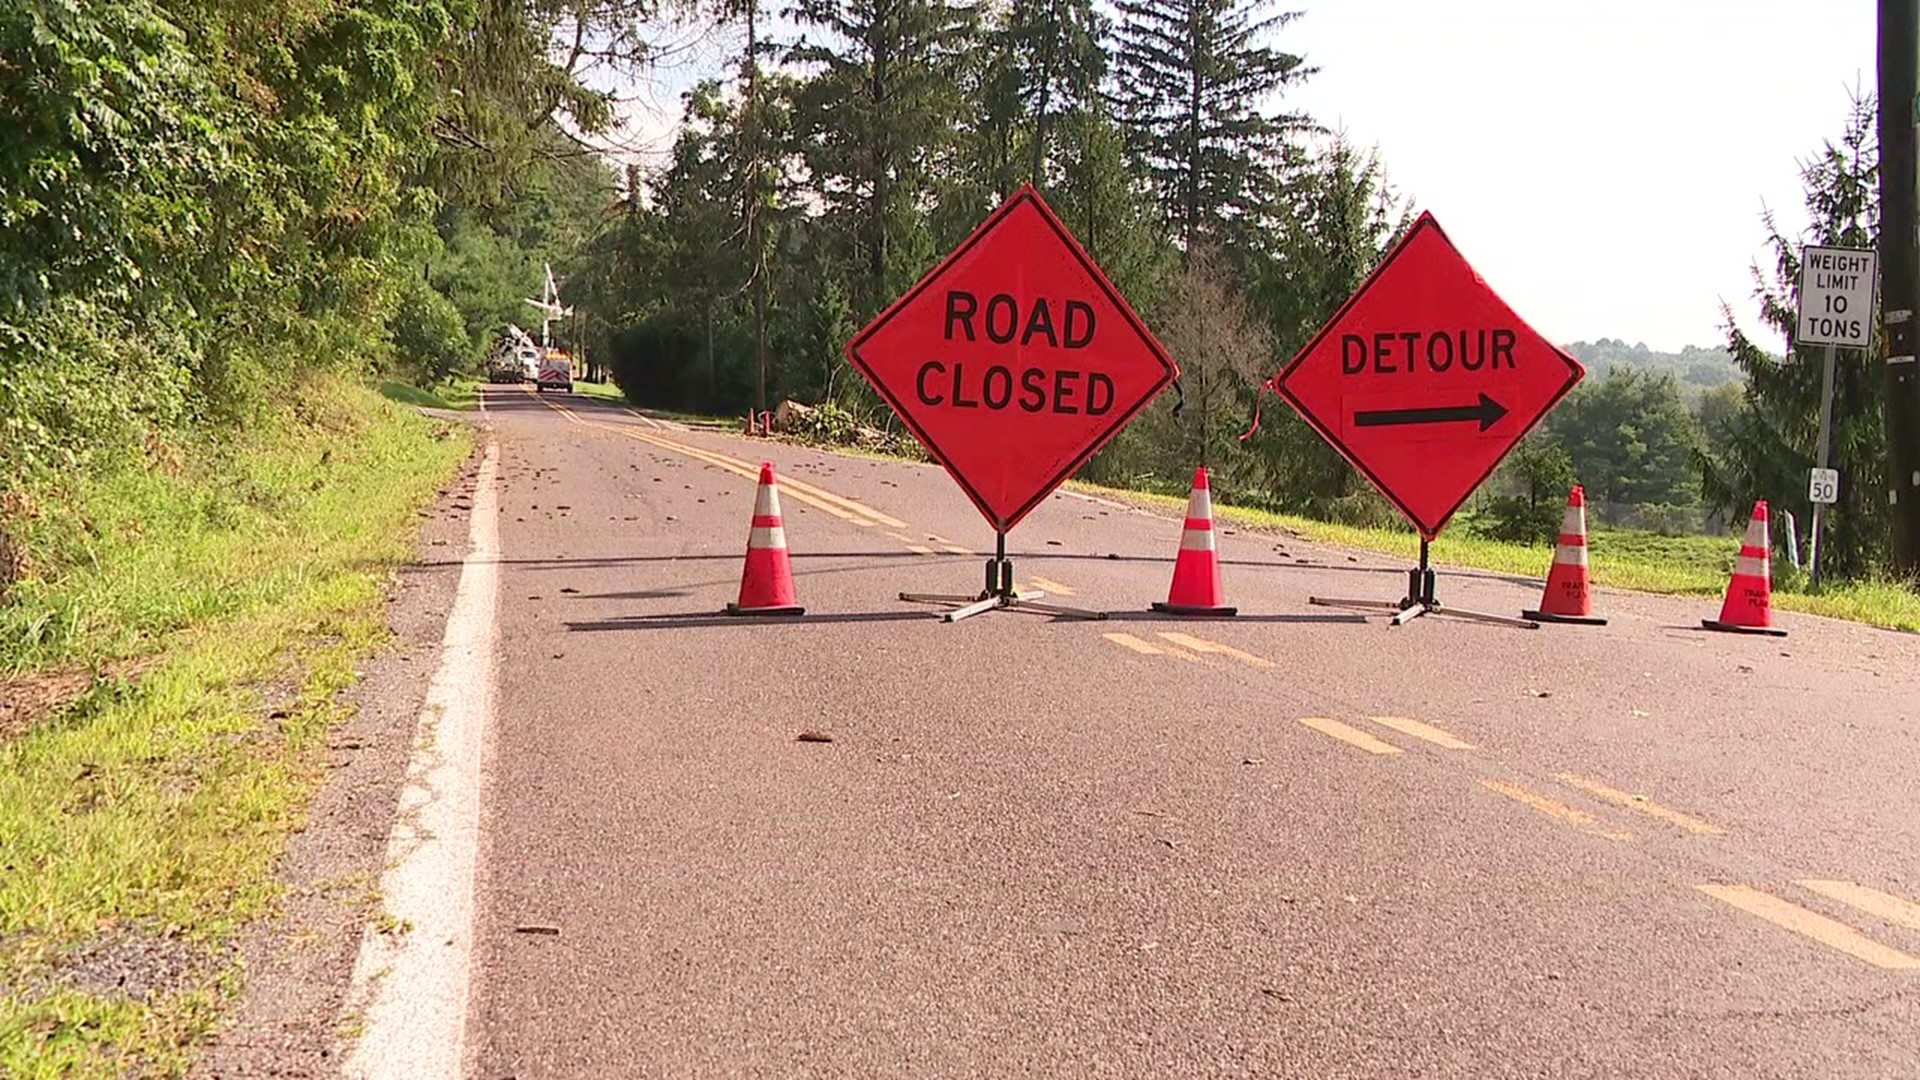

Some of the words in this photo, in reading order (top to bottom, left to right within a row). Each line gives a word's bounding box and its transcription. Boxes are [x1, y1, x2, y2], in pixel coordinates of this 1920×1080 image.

[1810, 254, 1870, 273] WEIGHT
[1817, 273, 1858, 290] LIMIT
[1825, 295, 1848, 314] 10
[944, 291, 1096, 348] ROAD
[1808, 317, 1861, 339] TONS
[1342, 329, 1516, 375] DETOUR
[916, 361, 1114, 416] CLOSED
[1813, 482, 1833, 499] 50
